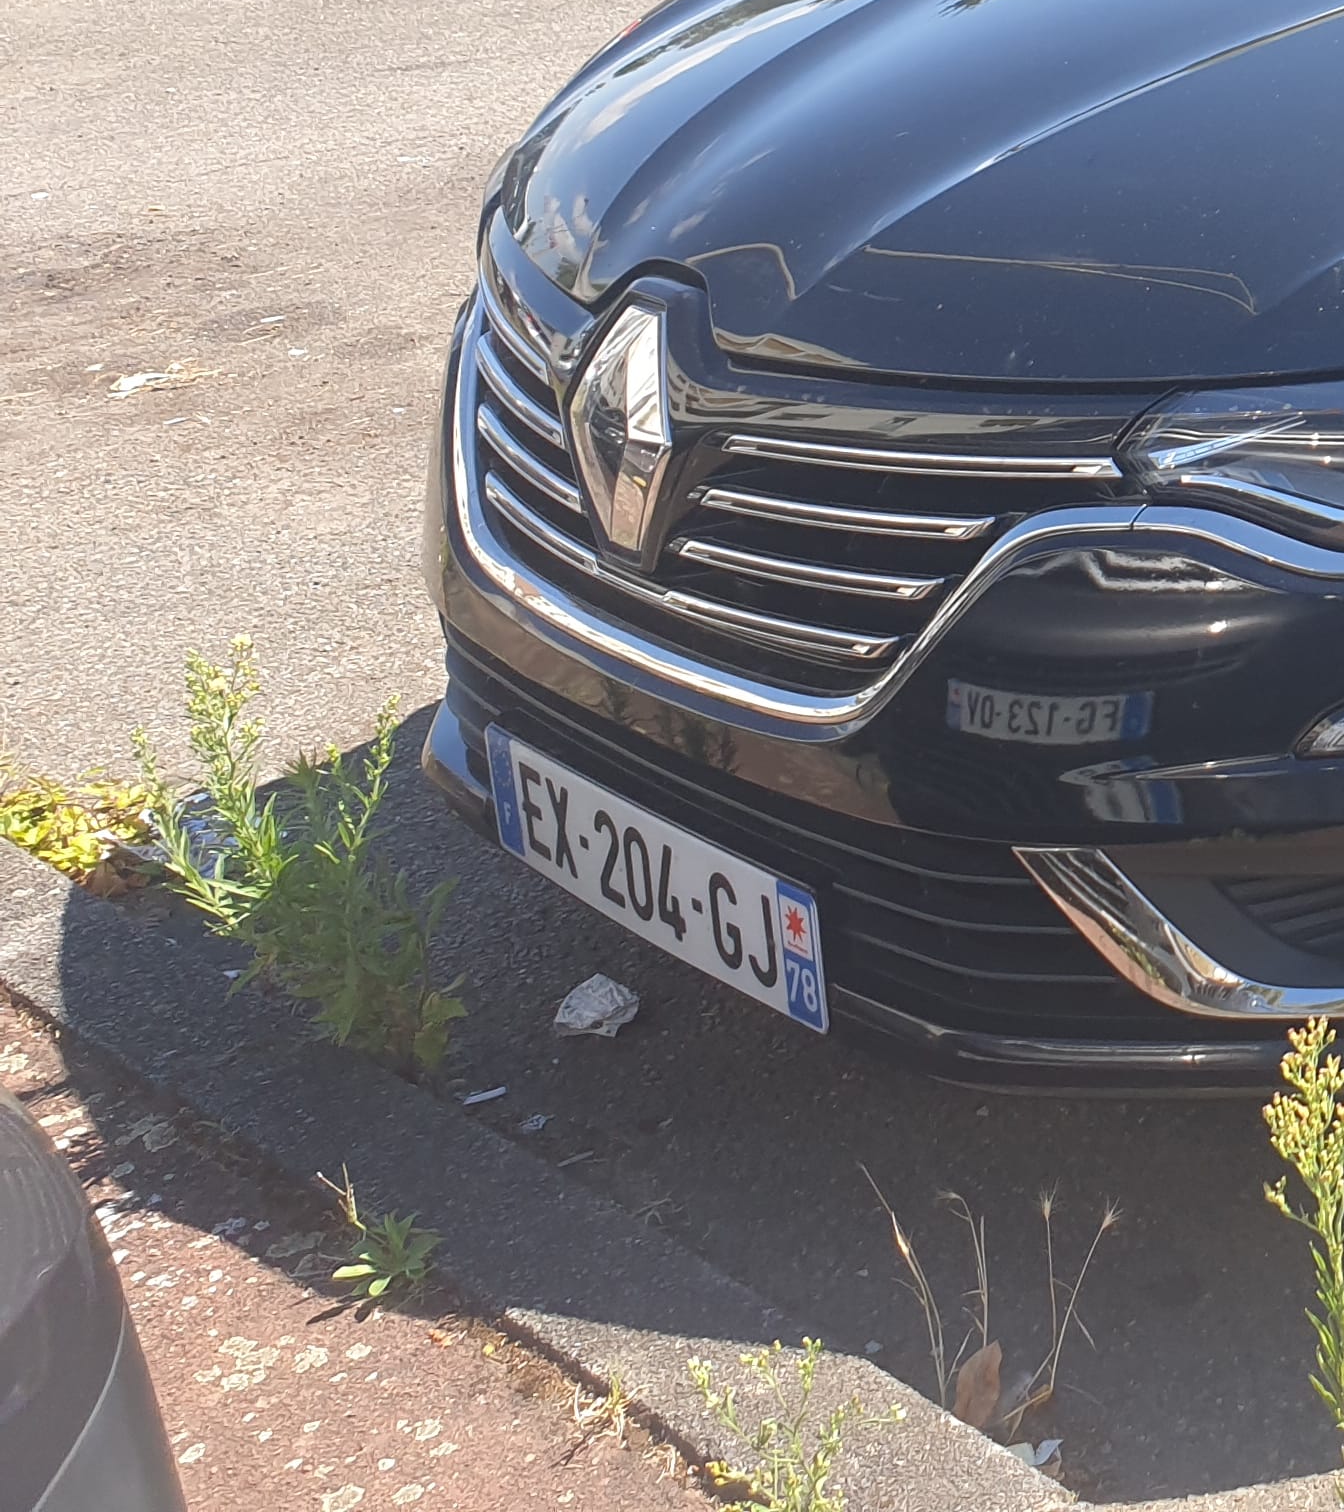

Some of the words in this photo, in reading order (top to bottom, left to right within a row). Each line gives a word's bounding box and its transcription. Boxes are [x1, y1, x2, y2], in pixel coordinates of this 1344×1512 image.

[503, 801, 513, 825] F
[518, 760, 778, 988] EX-204-GJ
[786, 958, 819, 1013] 78
